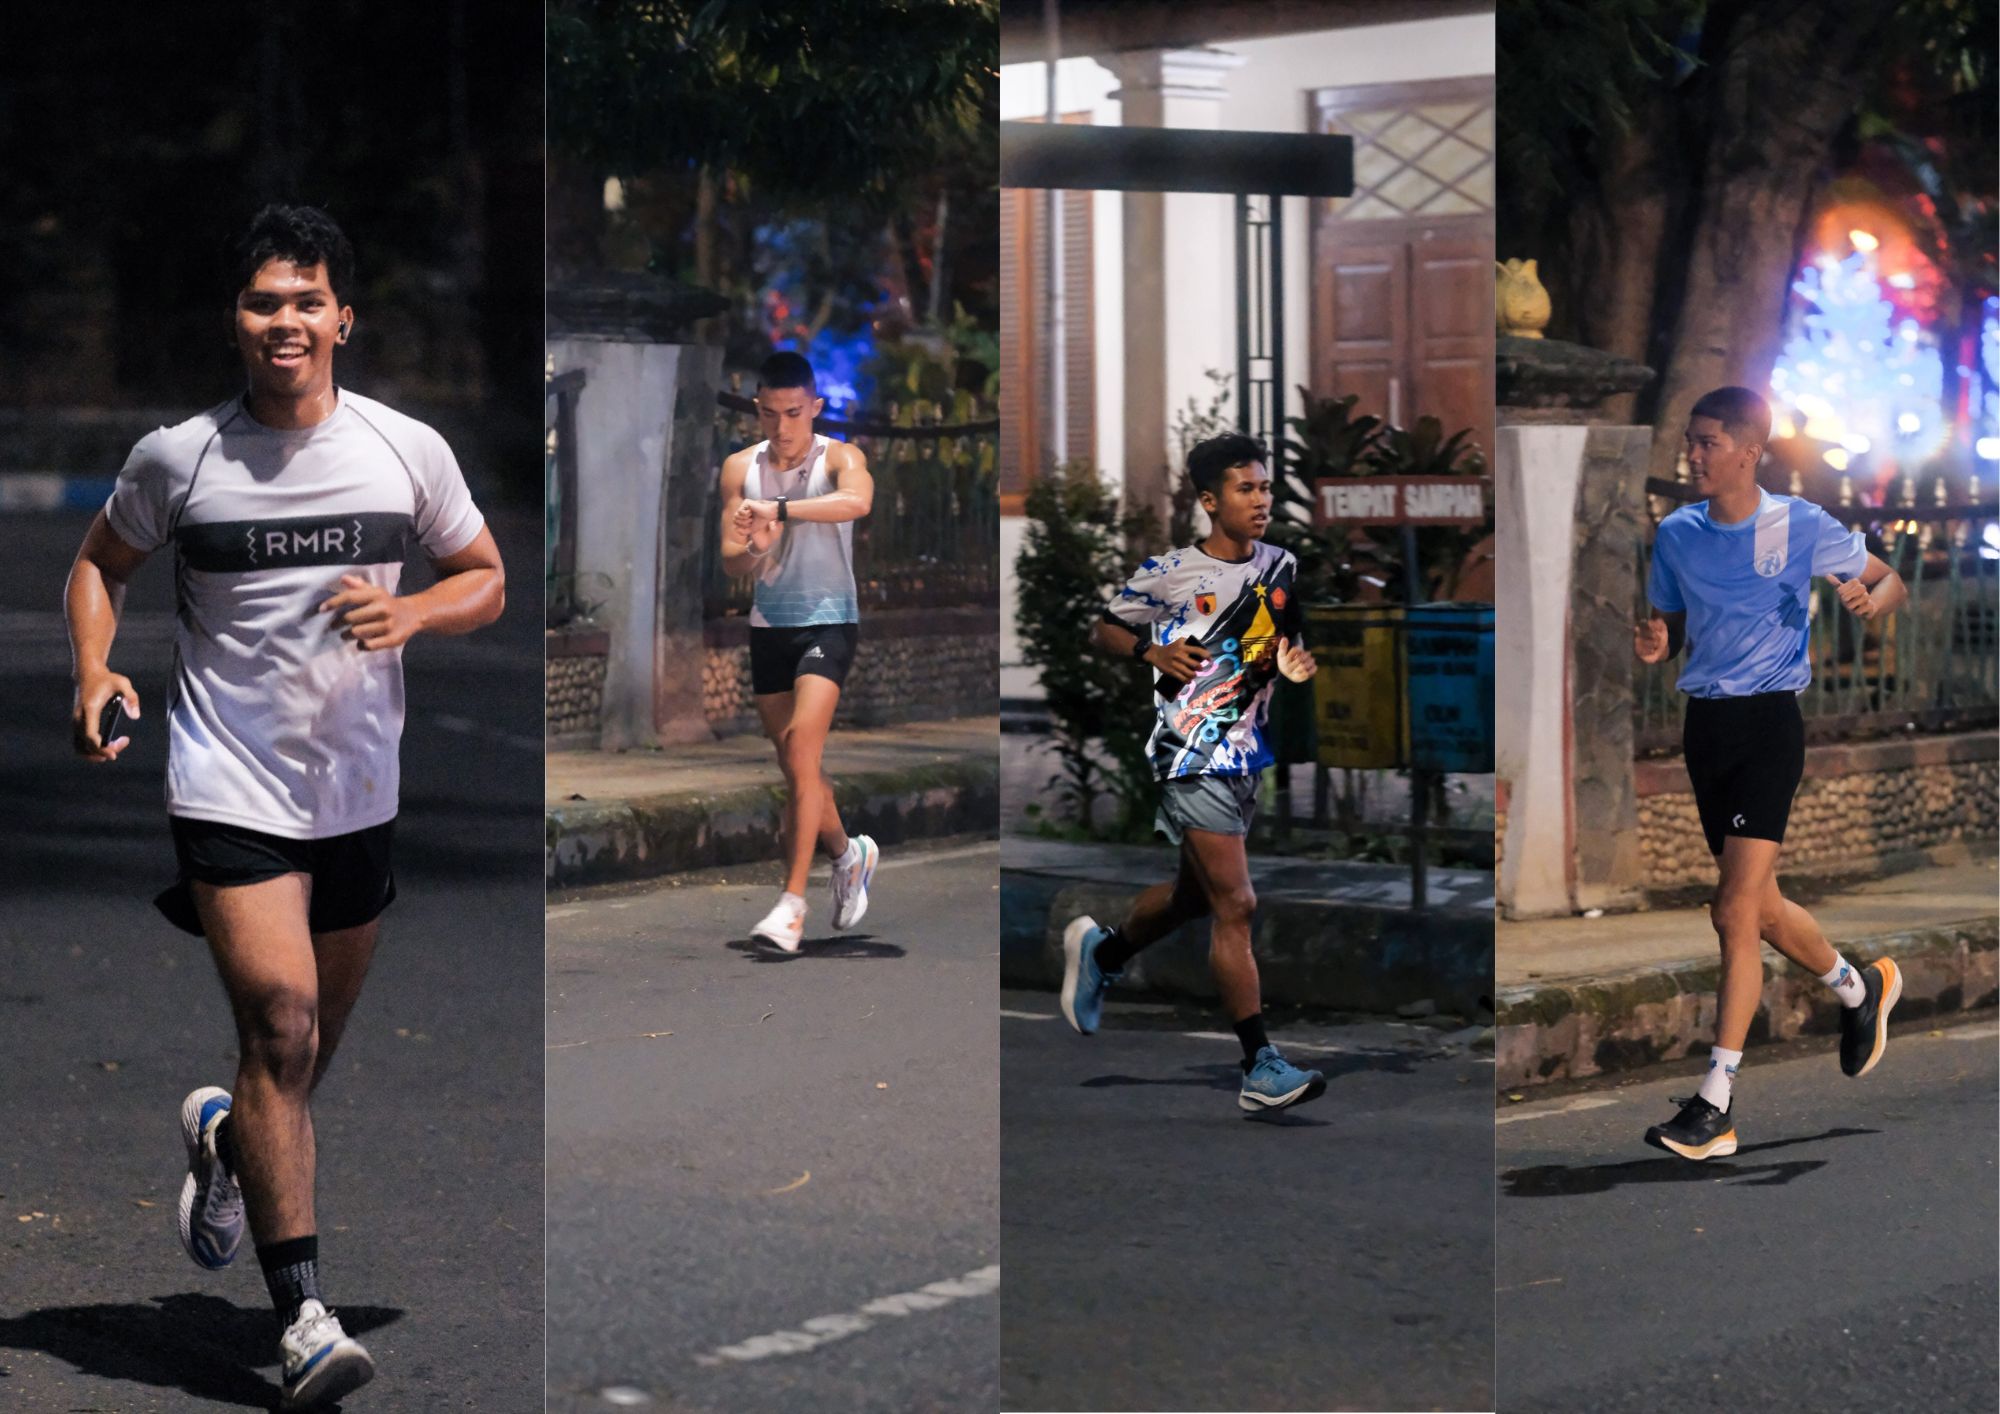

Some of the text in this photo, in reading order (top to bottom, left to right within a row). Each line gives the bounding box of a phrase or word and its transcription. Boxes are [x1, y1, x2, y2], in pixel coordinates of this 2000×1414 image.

[1321, 484, 1482, 517] TEMPAT SAMPAH
[265, 527, 347, 556] RMR
